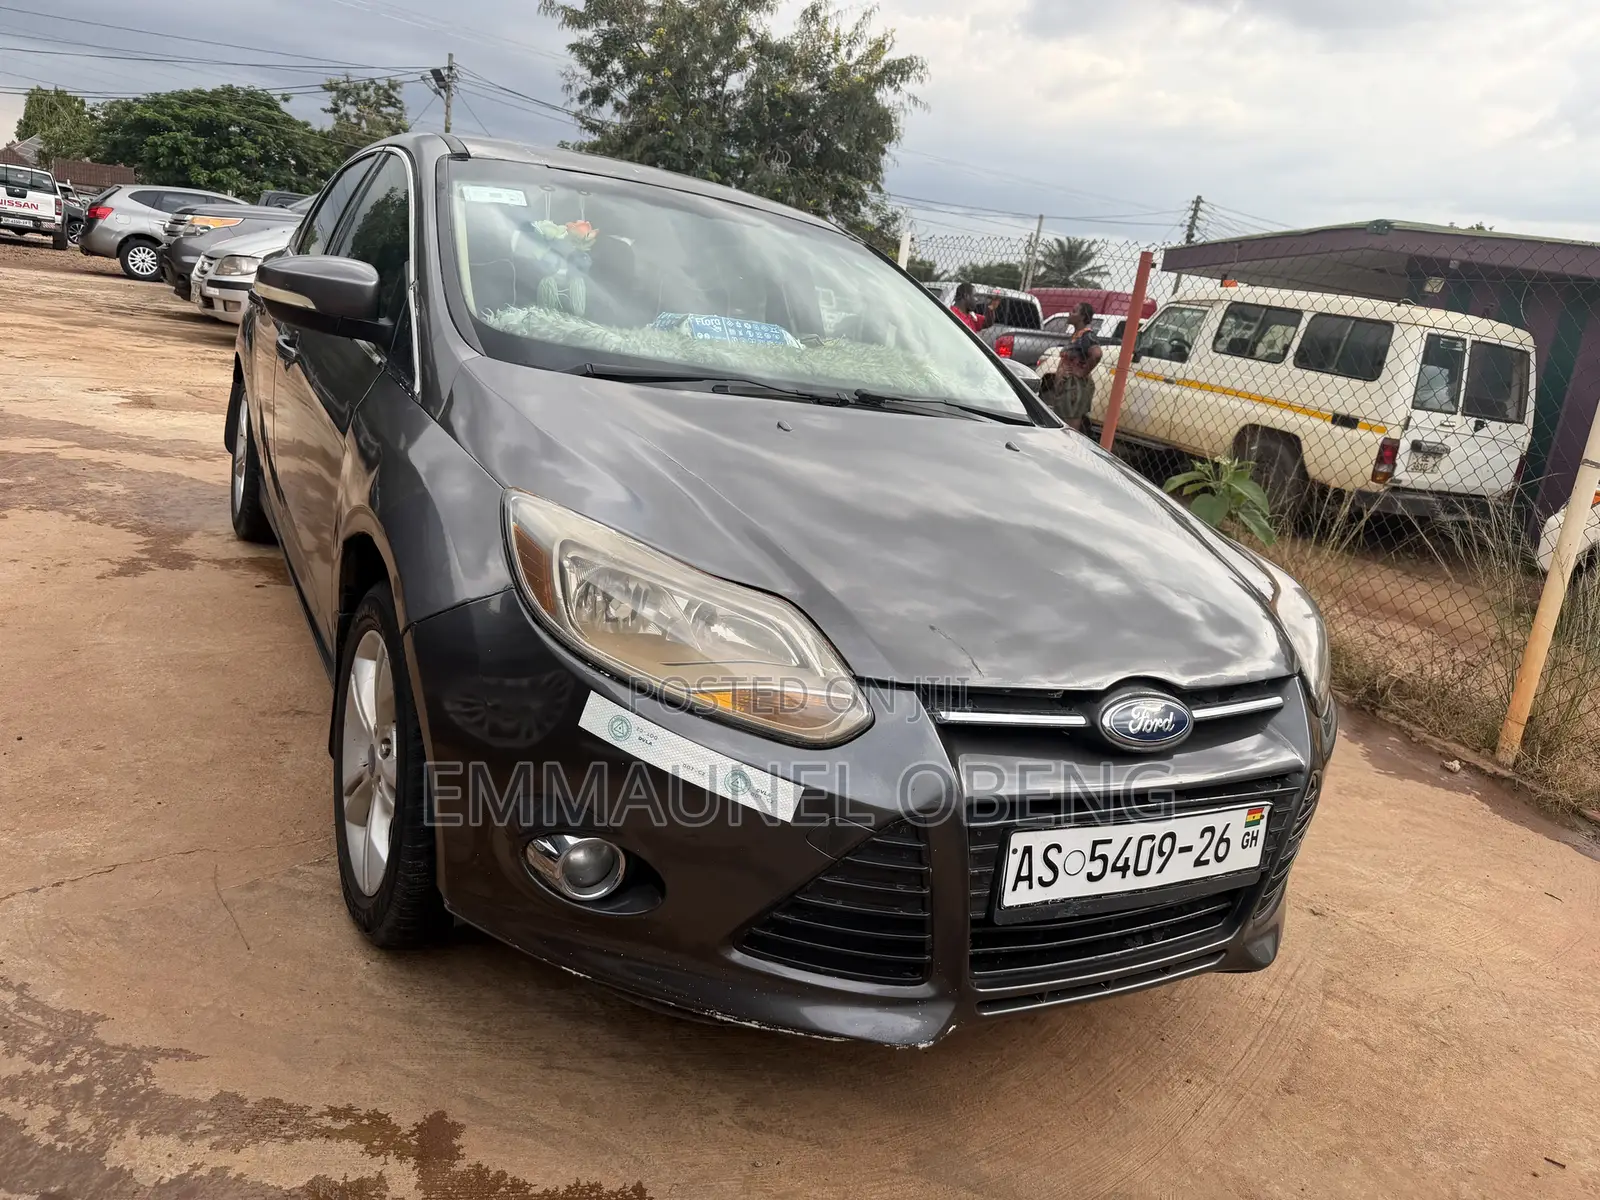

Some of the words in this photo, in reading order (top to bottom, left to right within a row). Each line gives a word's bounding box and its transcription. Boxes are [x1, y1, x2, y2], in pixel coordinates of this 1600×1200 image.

[695, 317, 721, 327] Flora
[1128, 703, 1176, 735] Ford
[638, 736, 653, 746] DVLA
[1241, 829, 1259, 850] GH
[1011, 842, 1063, 892] AS
[1086, 822, 1232, 883] 5409-26
